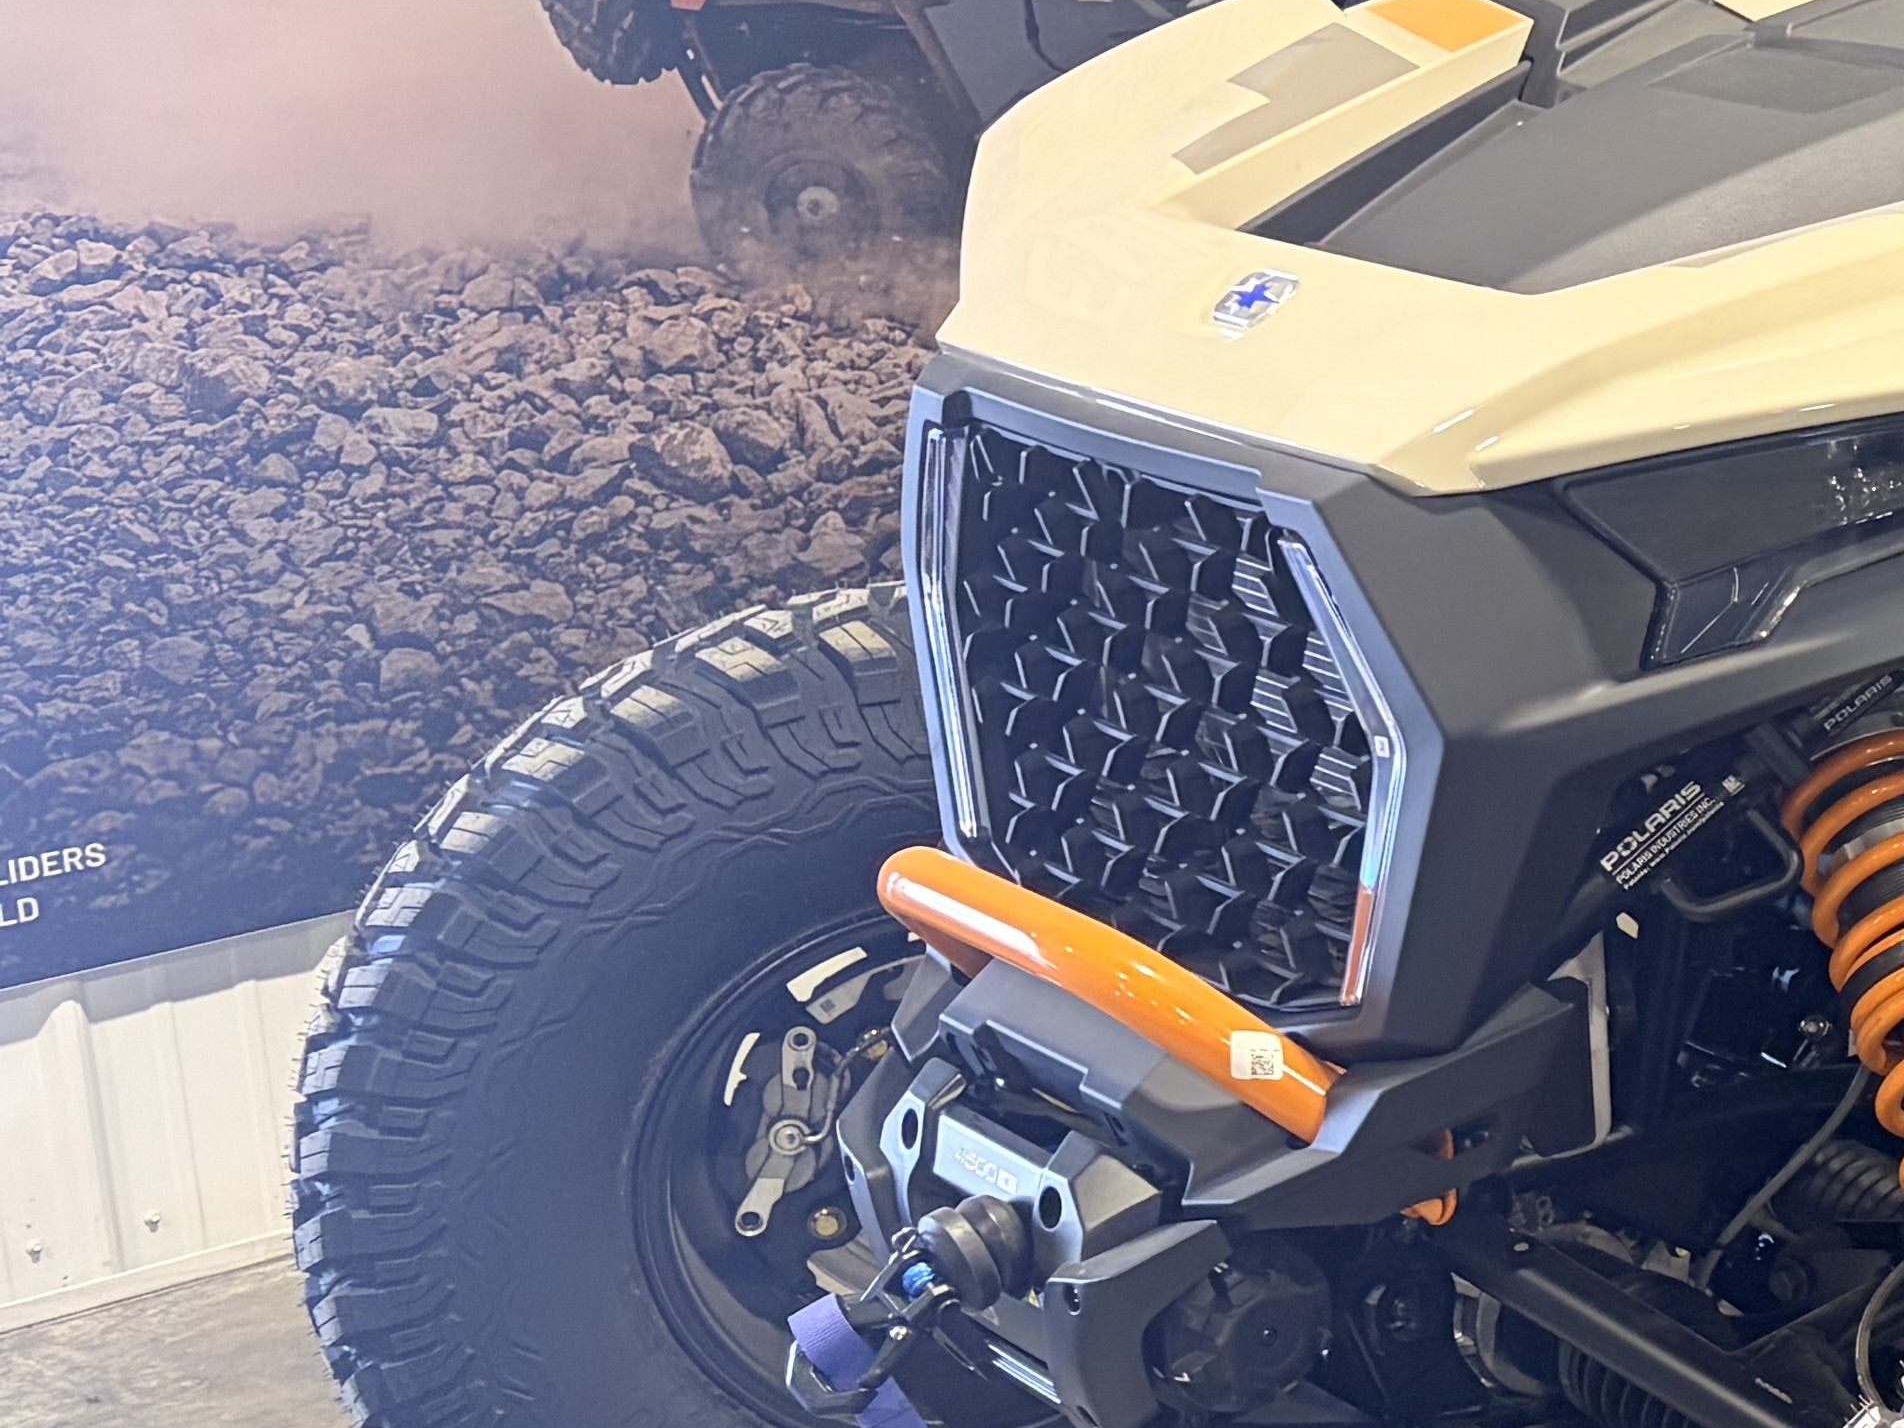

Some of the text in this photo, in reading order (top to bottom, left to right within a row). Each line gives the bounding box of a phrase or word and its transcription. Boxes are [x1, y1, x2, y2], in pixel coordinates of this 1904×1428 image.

[1824, 674, 1892, 731] POLARIS
[1600, 781, 1702, 872] POLARIS
[1616, 850, 1653, 885] POLARIS
[1651, 812, 1699, 854] INDUSTRIES
